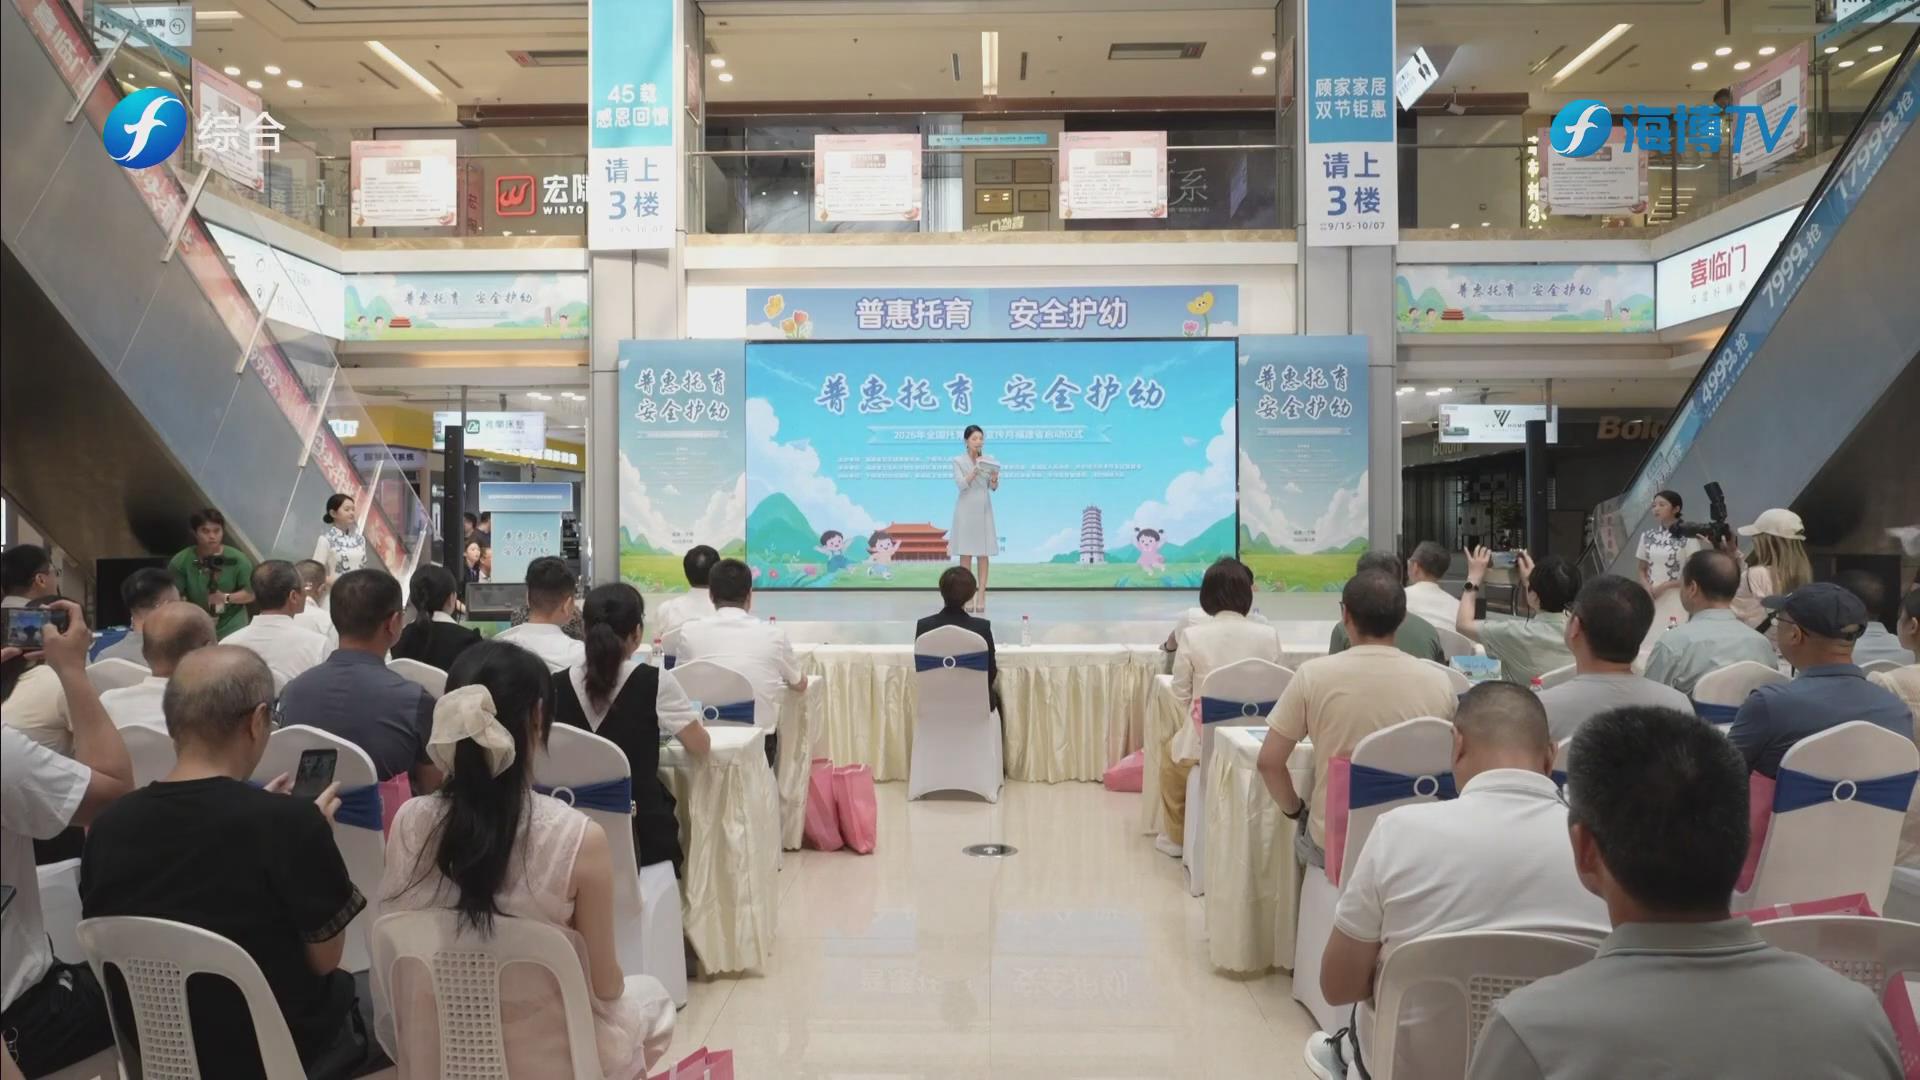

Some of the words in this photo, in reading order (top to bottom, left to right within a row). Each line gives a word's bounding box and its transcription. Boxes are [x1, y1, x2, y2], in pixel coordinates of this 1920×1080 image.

[607, 83, 657, 104] 45载
[1315, 77, 1387, 97] 顾家家居
[596, 107, 669, 129] 感恩回馈
[1315, 100, 1387, 120] 双节钜惠
[605, 157, 659, 184] 请上
[1323, 152, 1380, 179] 请上
[543, 205, 584, 215] WINTO
[608, 190, 659, 220] 3楼
[1327, 186, 1380, 216] 3楼
[1328, 222, 1385, 231] 9/15-10/07
[1690, 244, 1747, 289] 喜临门
[1531, 283, 1592, 297] 安全护幼
[856, 297, 973, 330] 普惠托育
[1009, 297, 1127, 330] 安全护幼
[636, 368, 726, 395] 普惠托育
[1256, 364, 1349, 392] 普惠托育
[816, 373, 972, 414] 普惠托育
[1000, 373, 1166, 414] 安全护幼
[636, 399, 729, 423] 安全护幼
[1256, 396, 1352, 420] 安全护幼
